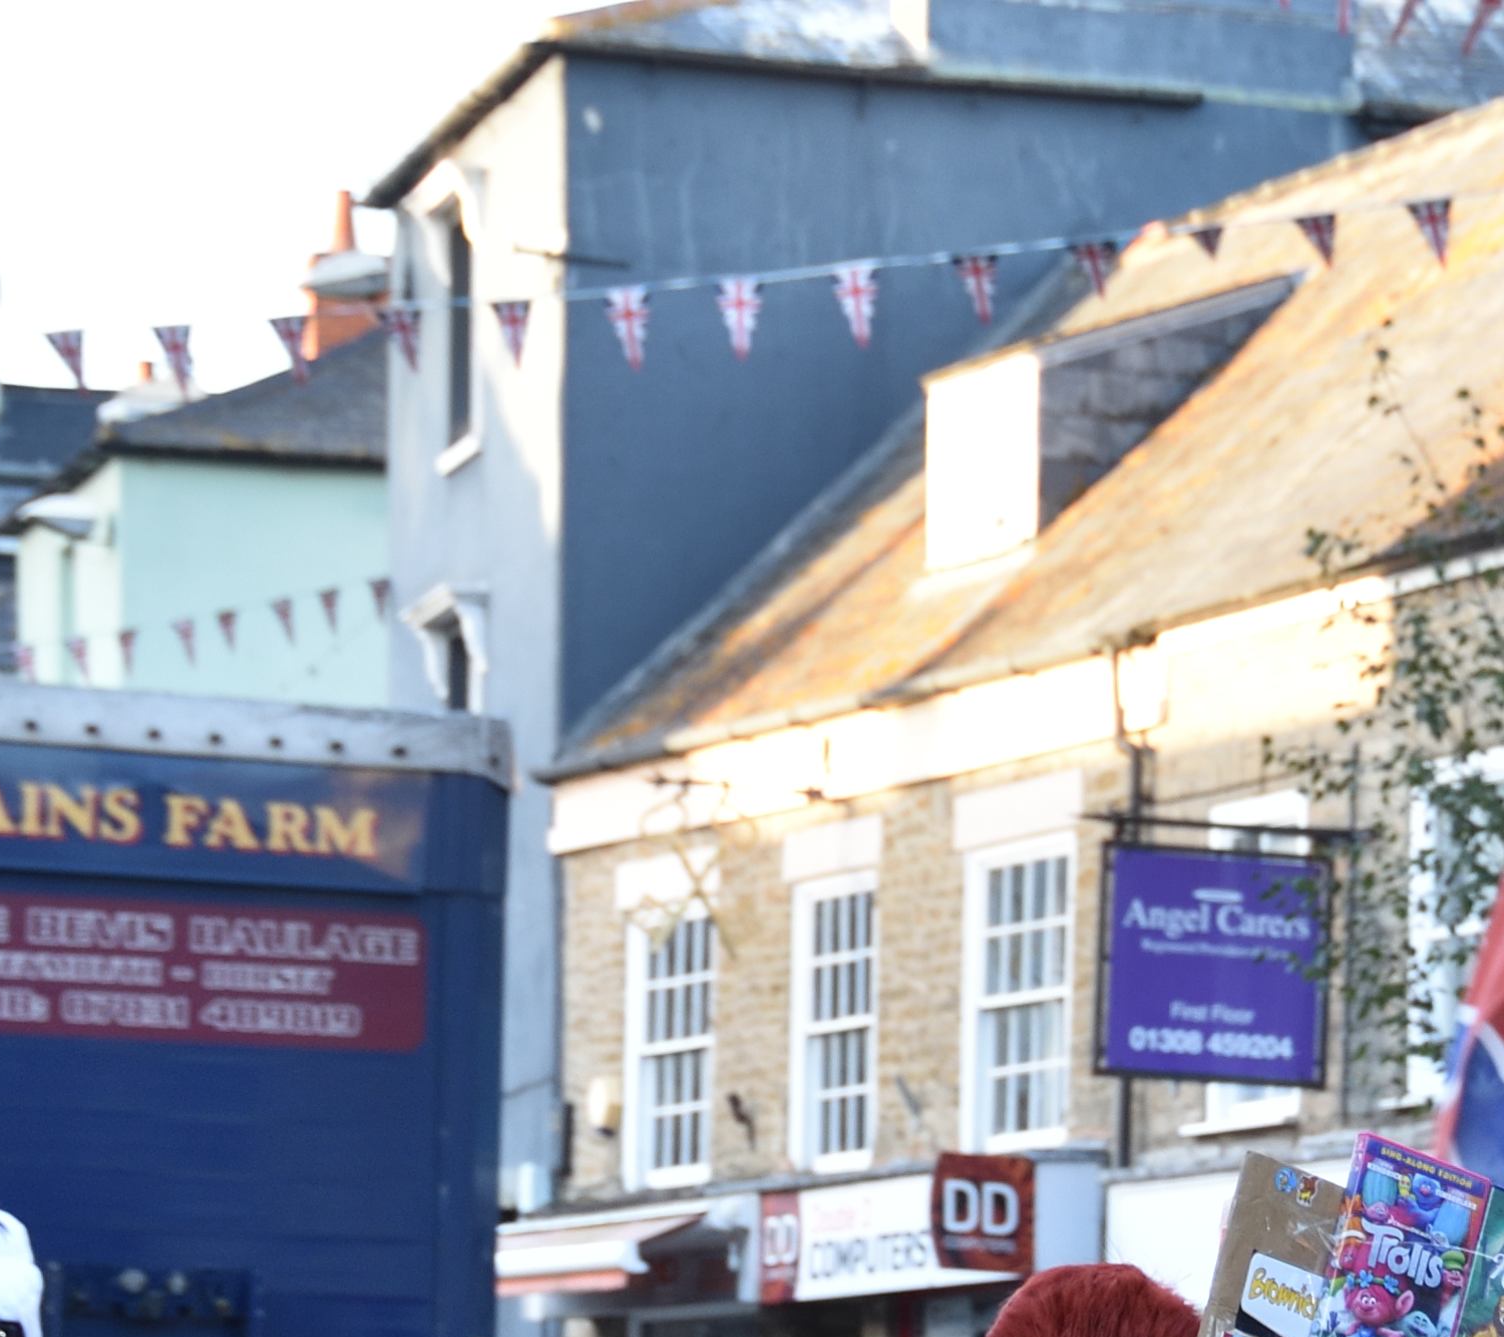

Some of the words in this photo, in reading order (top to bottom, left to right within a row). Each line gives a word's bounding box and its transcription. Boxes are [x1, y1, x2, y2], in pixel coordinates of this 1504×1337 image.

[164, 795, 380, 859] FARM
[188, 914, 420, 966] HAULAGE
[1122, 897, 1211, 939] Angel
[1216, 902, 1311, 940] Carers
[942, 1177, 1020, 1237] DD
[807, 1232, 931, 1281] COMPUTERS
[1361, 1216, 1444, 1289] Trolls
